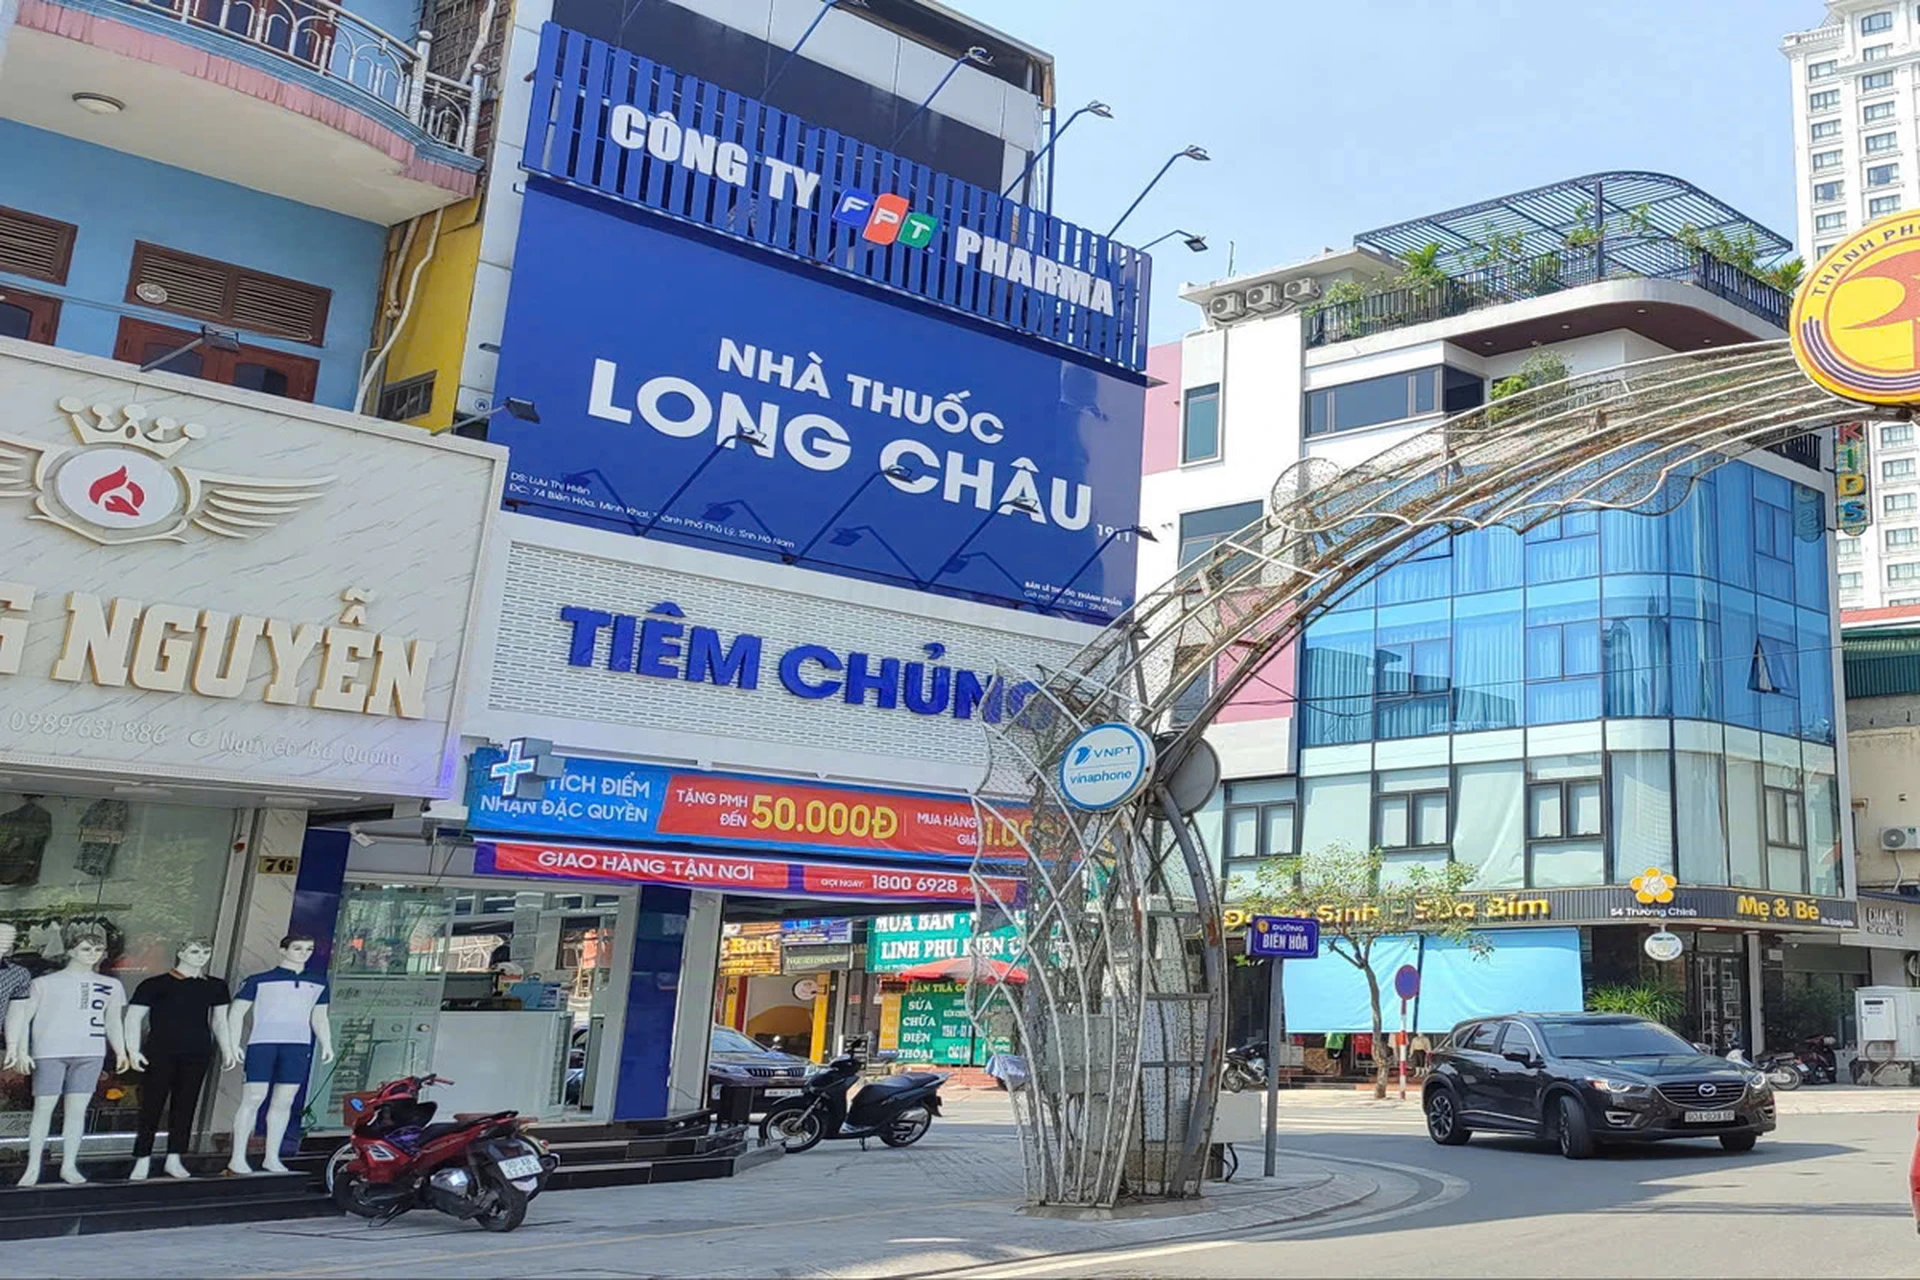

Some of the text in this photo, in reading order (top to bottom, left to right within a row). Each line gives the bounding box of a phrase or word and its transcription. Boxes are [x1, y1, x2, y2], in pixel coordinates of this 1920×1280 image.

[610, 104, 1114, 317] CÔNG TY FPT PHARMA
[1811, 224, 1920, 296] THANH PH
[717, 337, 1005, 444] NHÀ THUỐC
[588, 358, 1092, 531] LONG CHÂU
[1838, 422, 1867, 522] KIDS
[599, 501, 625, 515] Minh
[773, 537, 796, 549] Nam
[51, 587, 438, 719] NGUYỄN
[561, 601, 763, 690] TIÊM
[1093, 744, 1135, 758] VNPT
[601, 771, 650, 799] ĐIỂM
[1070, 770, 1132, 785] vinaphone
[541, 798, 583, 821] ĐẶC
[587, 801, 648, 822] QUYỀN
[676, 789, 749, 807] TẶNG PMH
[719, 810, 748, 827] ĐẾN
[751, 794, 898, 839] 50.000Đ
[917, 812, 978, 829] MUA HÀNG
[957, 833, 978, 847] GIÁ
[265, 858, 294, 873] 76
[538, 851, 754, 881] GIAO HÀNG TẬN NƠI
[872, 874, 911, 891] 1800
[916, 877, 958, 893] 6928
[1737, 896, 1820, 922] Mẹ & Bé
[874, 915, 914, 932] MUA
[881, 939, 920, 959] LINH
[1262, 932, 1308, 950] BIÊN HÒA
